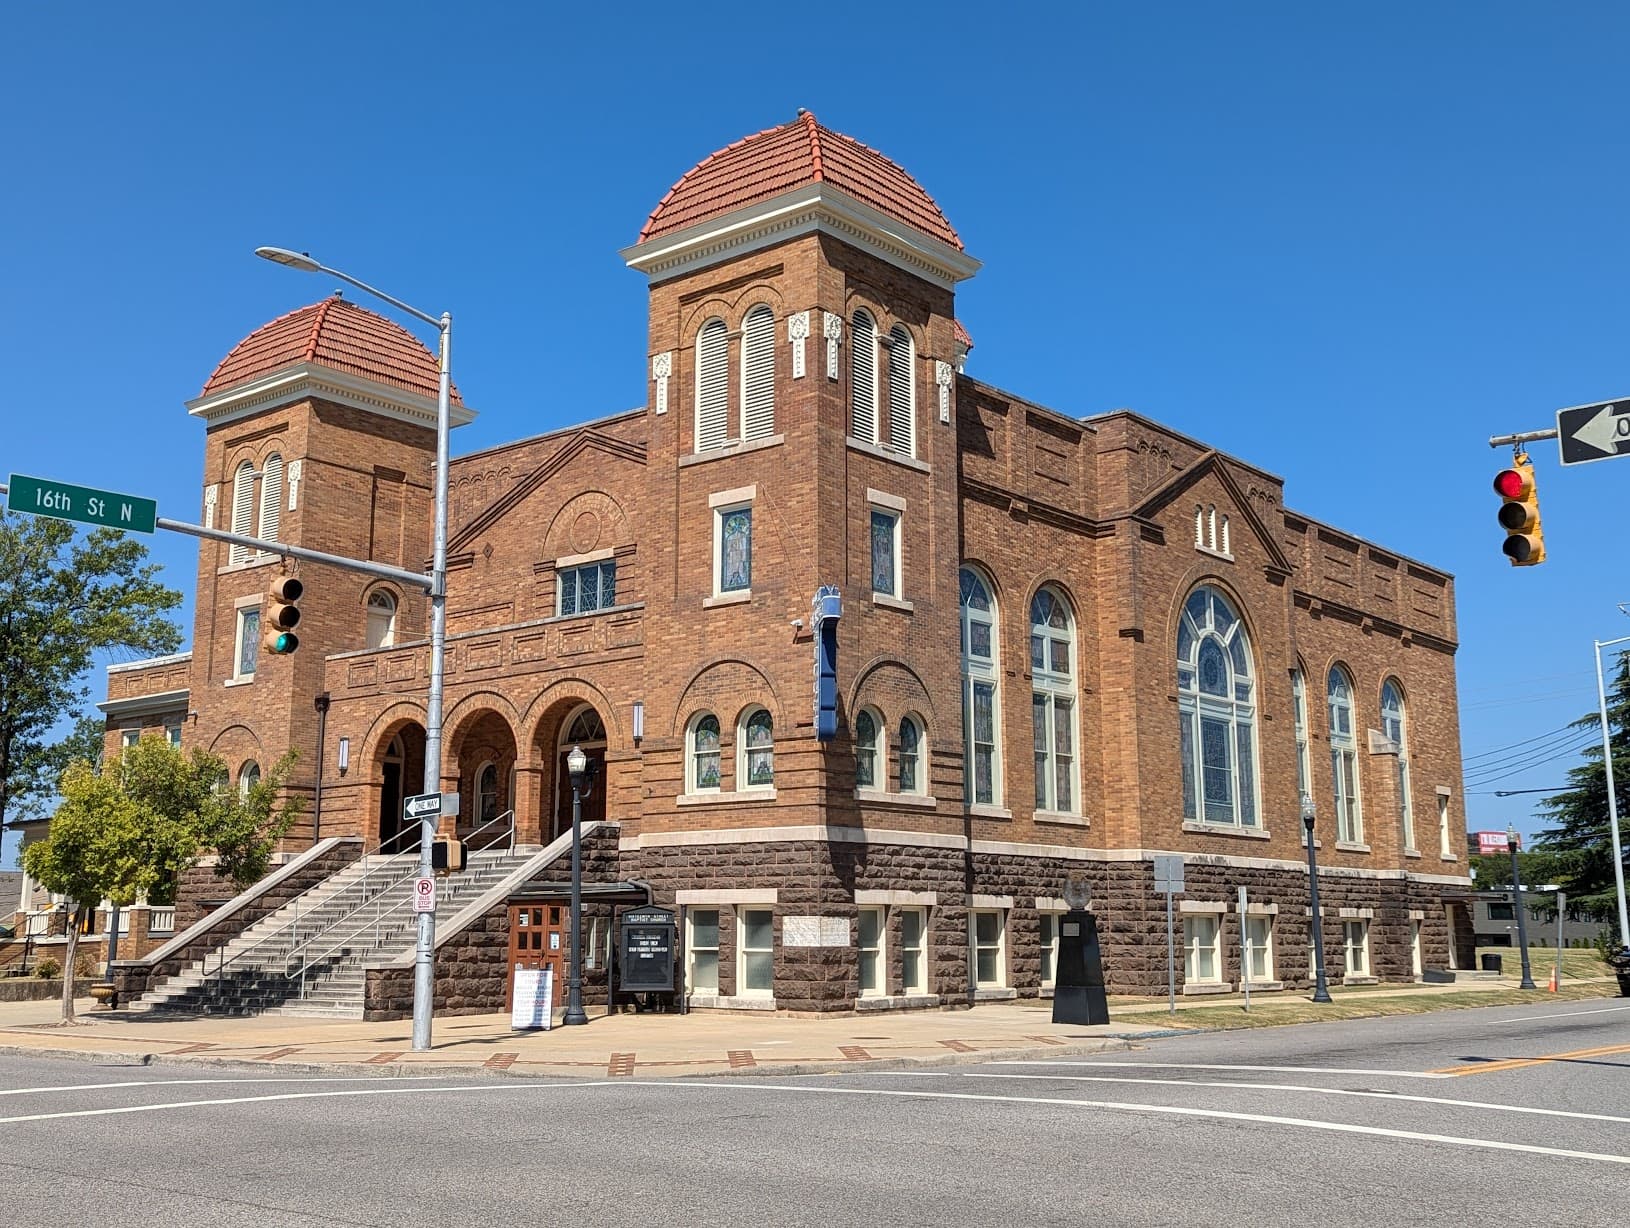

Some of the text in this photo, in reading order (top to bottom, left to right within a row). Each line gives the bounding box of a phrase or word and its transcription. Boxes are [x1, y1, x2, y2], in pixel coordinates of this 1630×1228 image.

[36, 487, 132, 522] 16th St N
[427, 799, 438, 809] WAY
